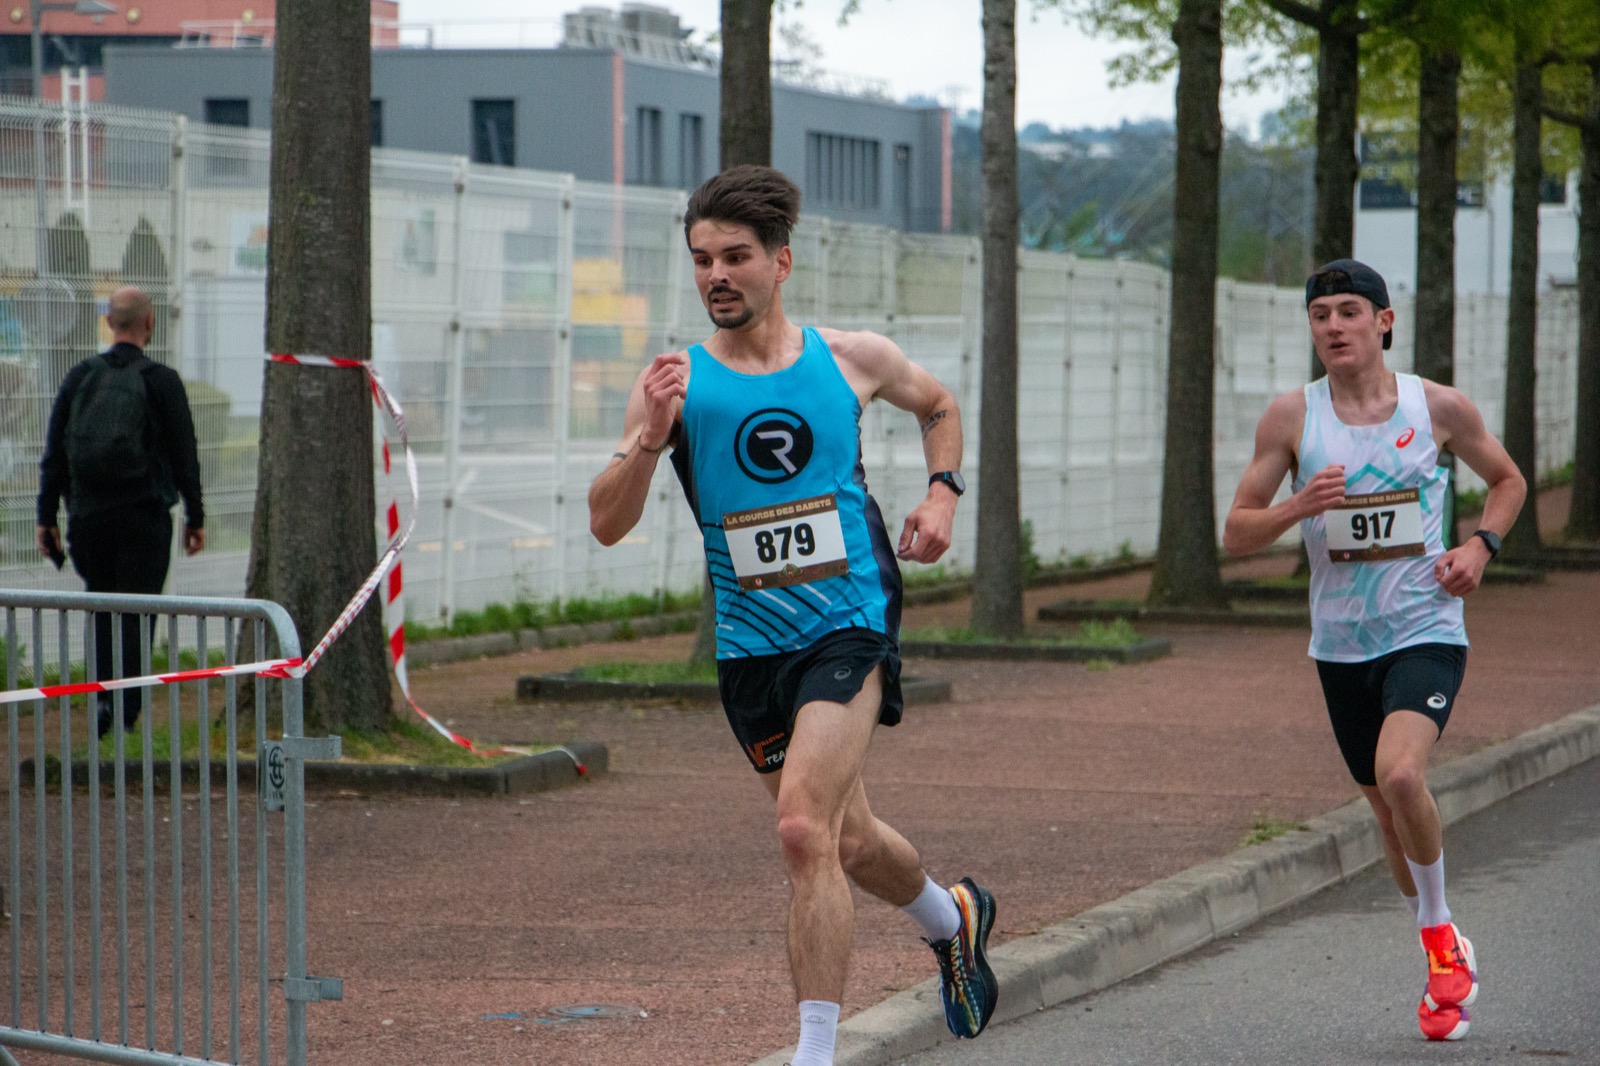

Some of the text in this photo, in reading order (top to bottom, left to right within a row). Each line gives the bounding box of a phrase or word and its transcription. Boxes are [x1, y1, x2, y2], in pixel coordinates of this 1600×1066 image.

[726, 498, 832, 525] LA COURSE DES BABETS
[1342, 491, 1416, 505] OURSE DES BABETS
[1351, 510, 1396, 541] 917
[754, 522, 816, 564] 879
[765, 748, 787, 765] TEA
